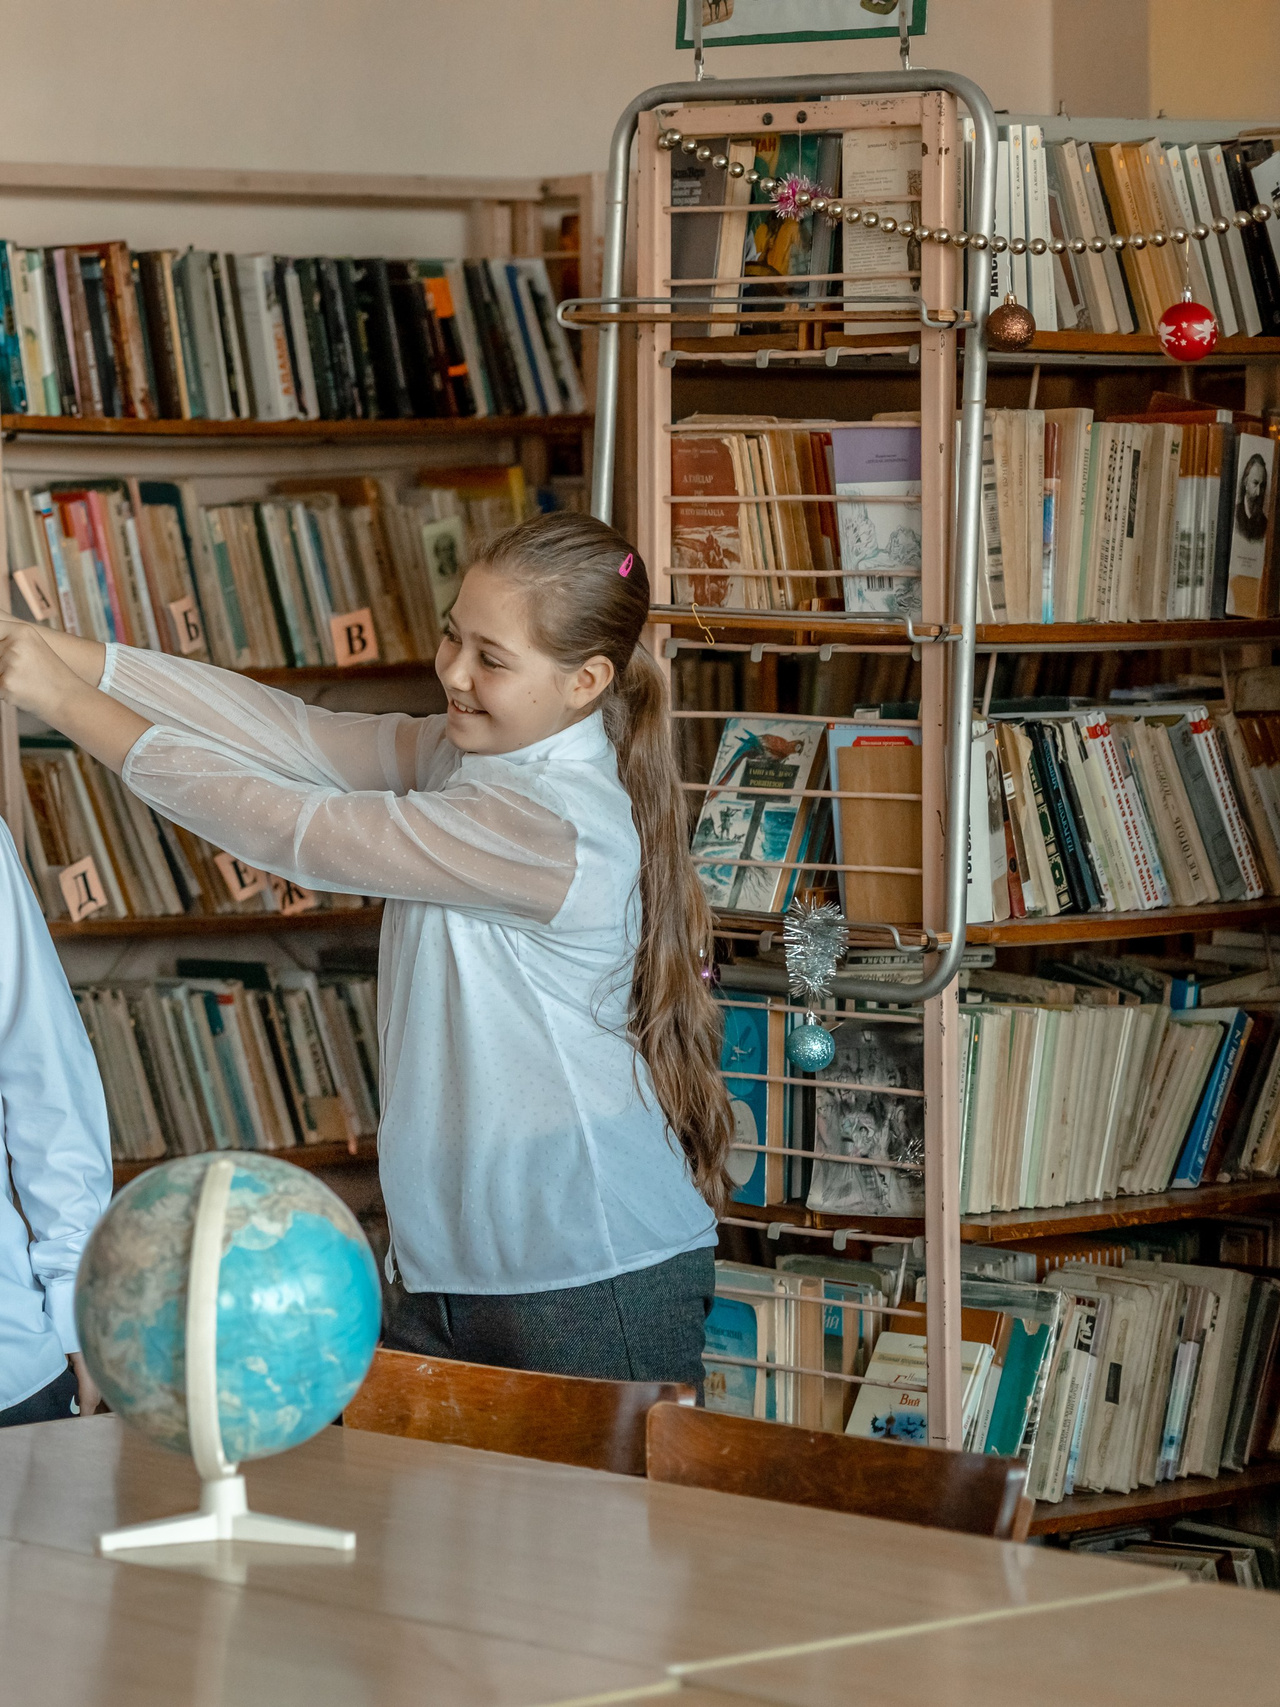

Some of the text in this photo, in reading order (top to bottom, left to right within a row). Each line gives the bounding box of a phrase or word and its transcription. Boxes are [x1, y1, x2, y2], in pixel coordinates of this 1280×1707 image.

[185, 611, 199, 641] Б
[345, 623, 368, 655] В
[232, 859, 259, 890] Е
[72, 869, 99, 914] Д
[1227, 1047, 1237, 1066] Над
[898, 1392, 922, 1408] Вий
